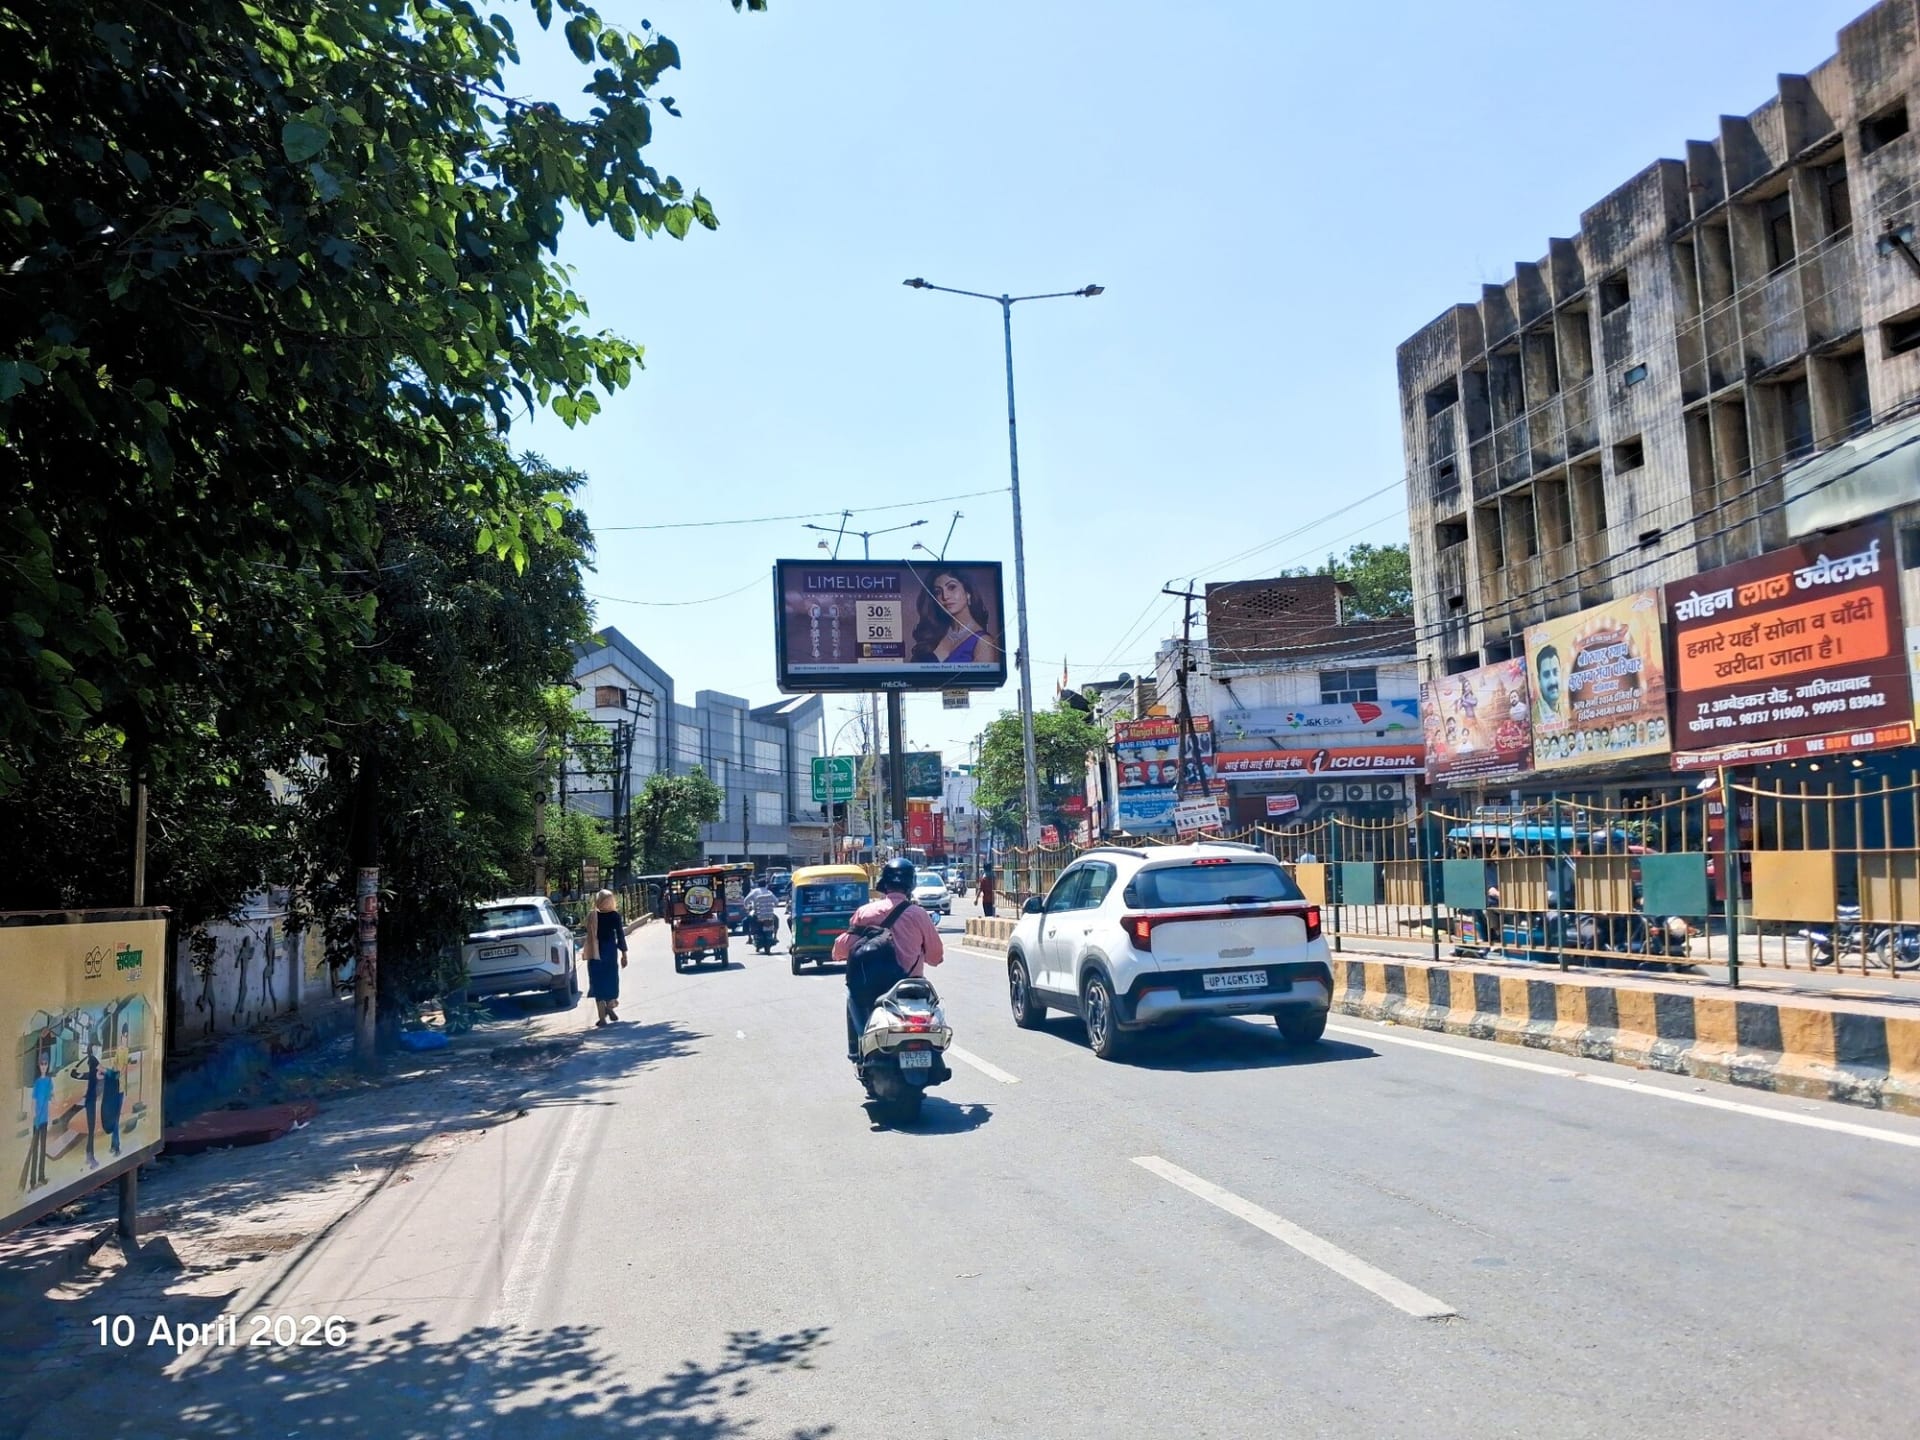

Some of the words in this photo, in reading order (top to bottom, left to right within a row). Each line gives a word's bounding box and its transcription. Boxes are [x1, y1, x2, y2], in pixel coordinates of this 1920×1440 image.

[808, 575, 896, 589] LIMELIGHT
[1675, 588, 1734, 621] सोहन
[1737, 573, 1791, 607] लाल
[1686, 631, 1725, 658] हमारे
[1729, 622, 1760, 647] यहाँ
[1764, 616, 1806, 641] सोना
[1812, 613, 1826, 629] व
[1830, 597, 1873, 625] चाँदी
[1714, 650, 1764, 678] खरीदा
[1769, 645, 1813, 667] जाता
[1698, 703, 1709, 715] 72
[1323, 716, 1343, 725] Bank
[1688, 718, 1714, 733] फोन
[1806, 739, 1825, 752] WE
[1851, 733, 1874, 747] OLD
[1330, 756, 1370, 768] ICICI
[1373, 754, 1416, 768] Bank
